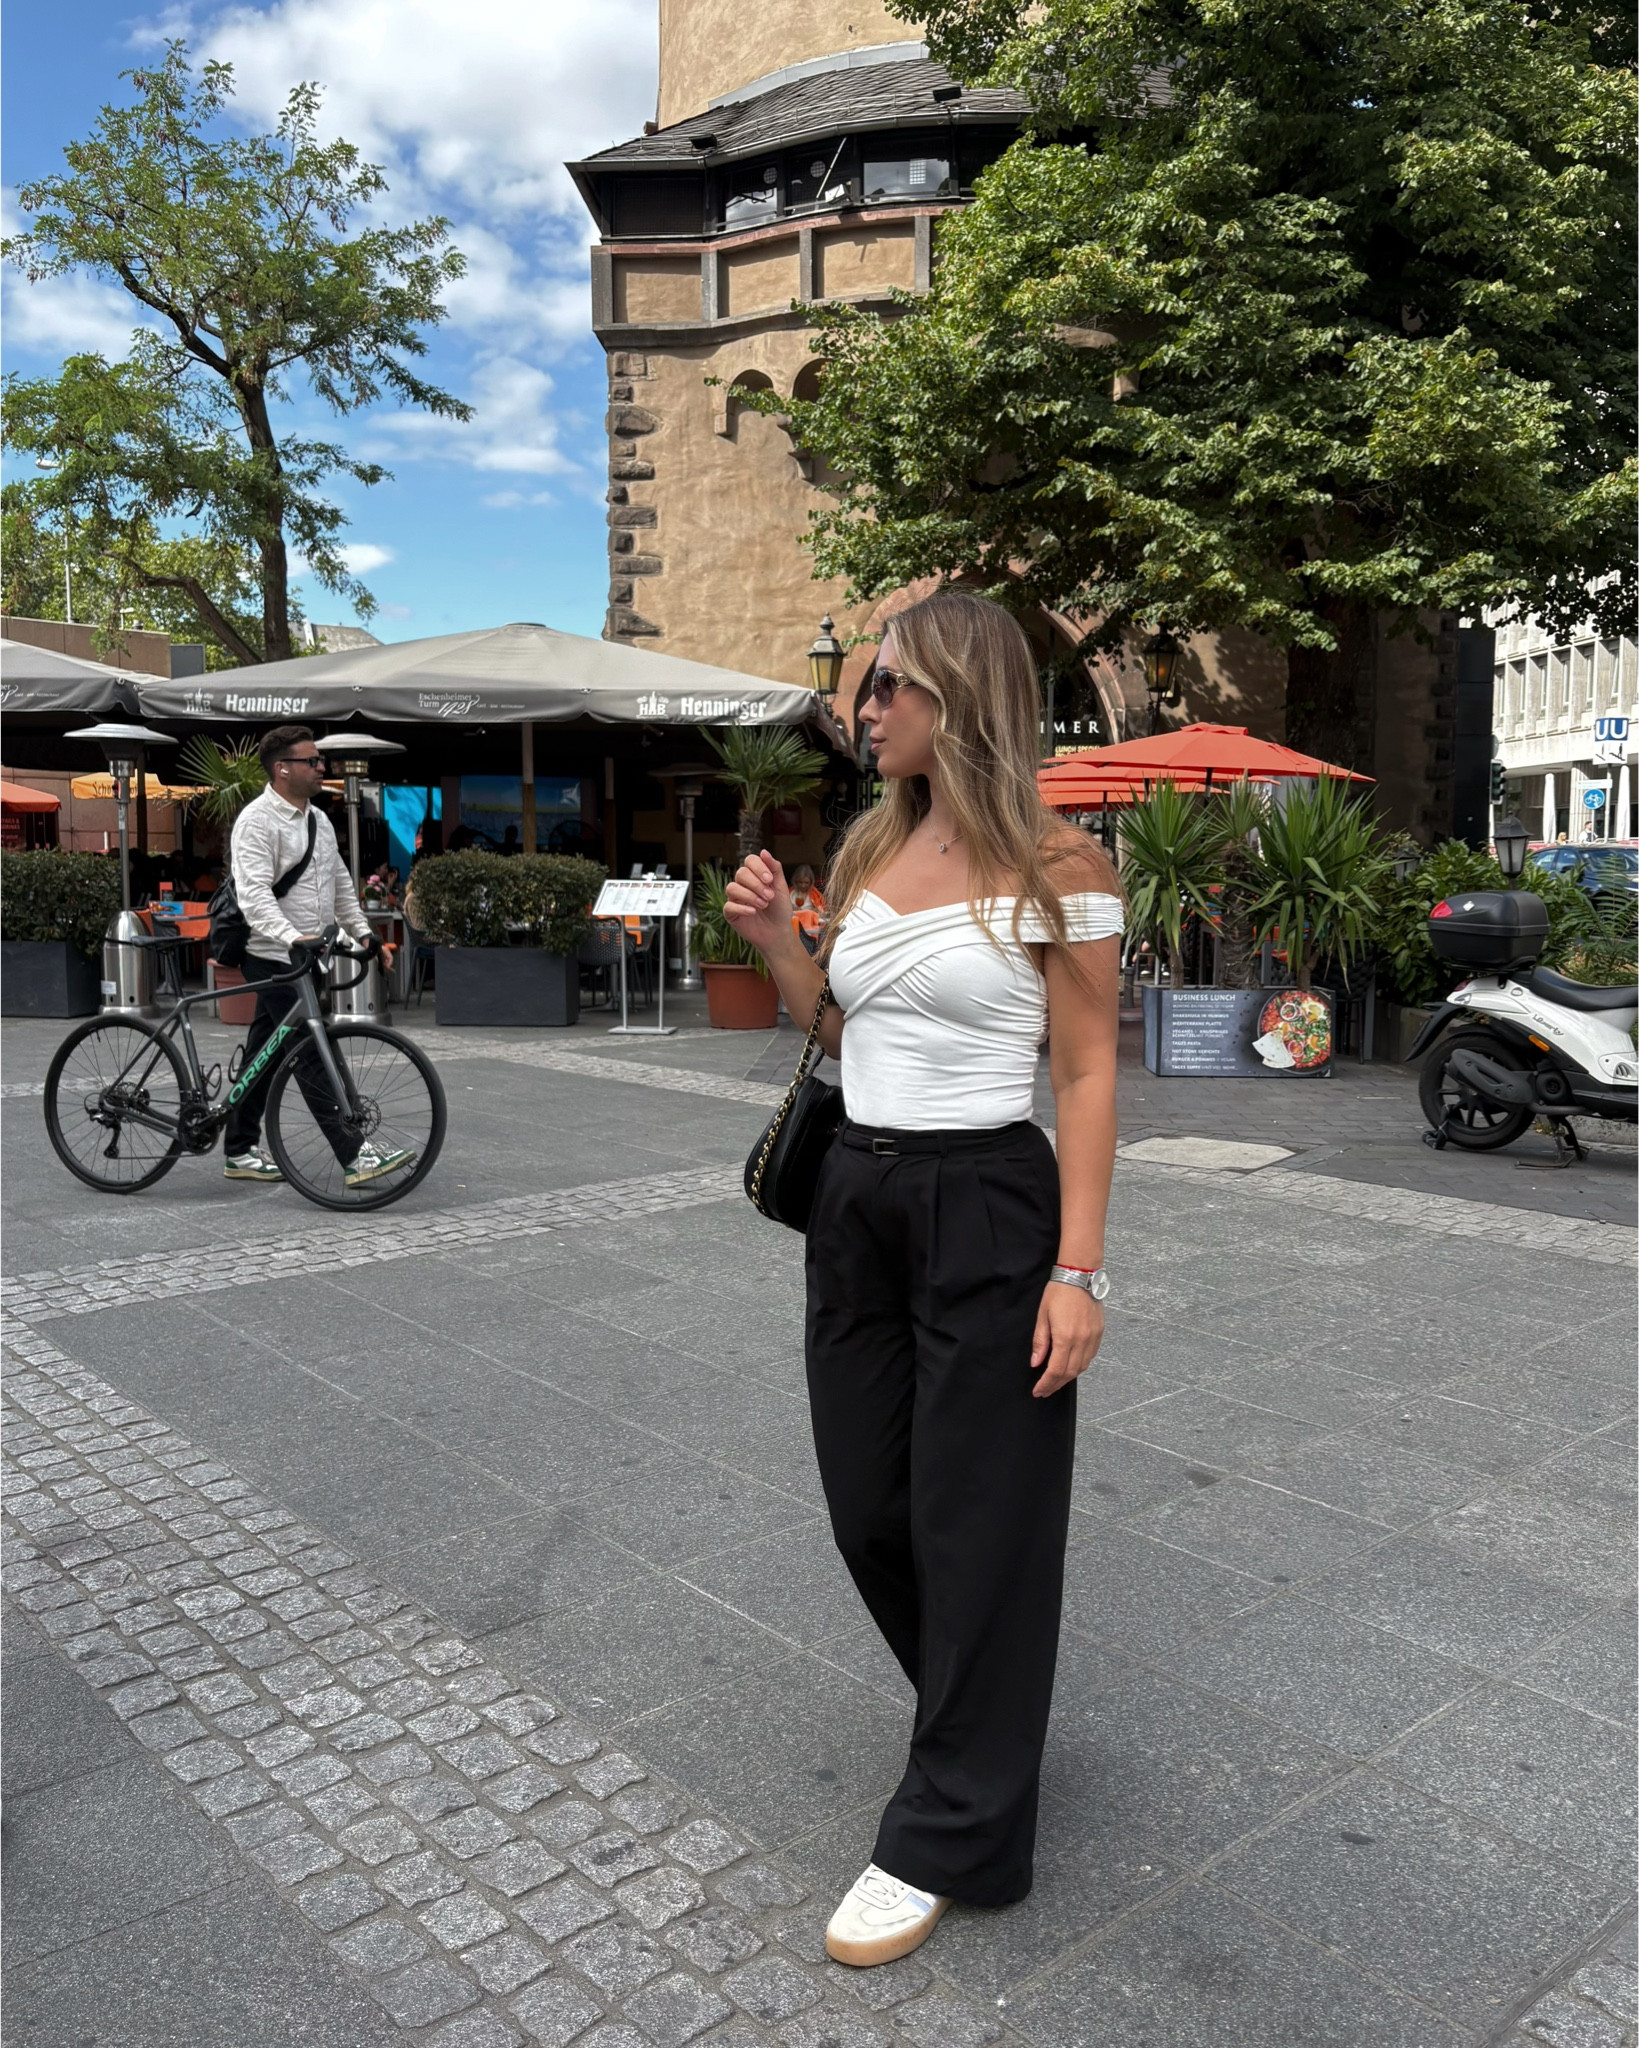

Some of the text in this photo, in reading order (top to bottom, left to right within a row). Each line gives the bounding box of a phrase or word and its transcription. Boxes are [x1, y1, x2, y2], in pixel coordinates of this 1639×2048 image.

[225, 694, 309, 715] Henninger
[418, 700, 440, 708] Turm
[419, 692, 472, 701] Eschenheimer
[680, 697, 767, 720] Henninger
[229, 1025, 292, 1104] ORBEA
